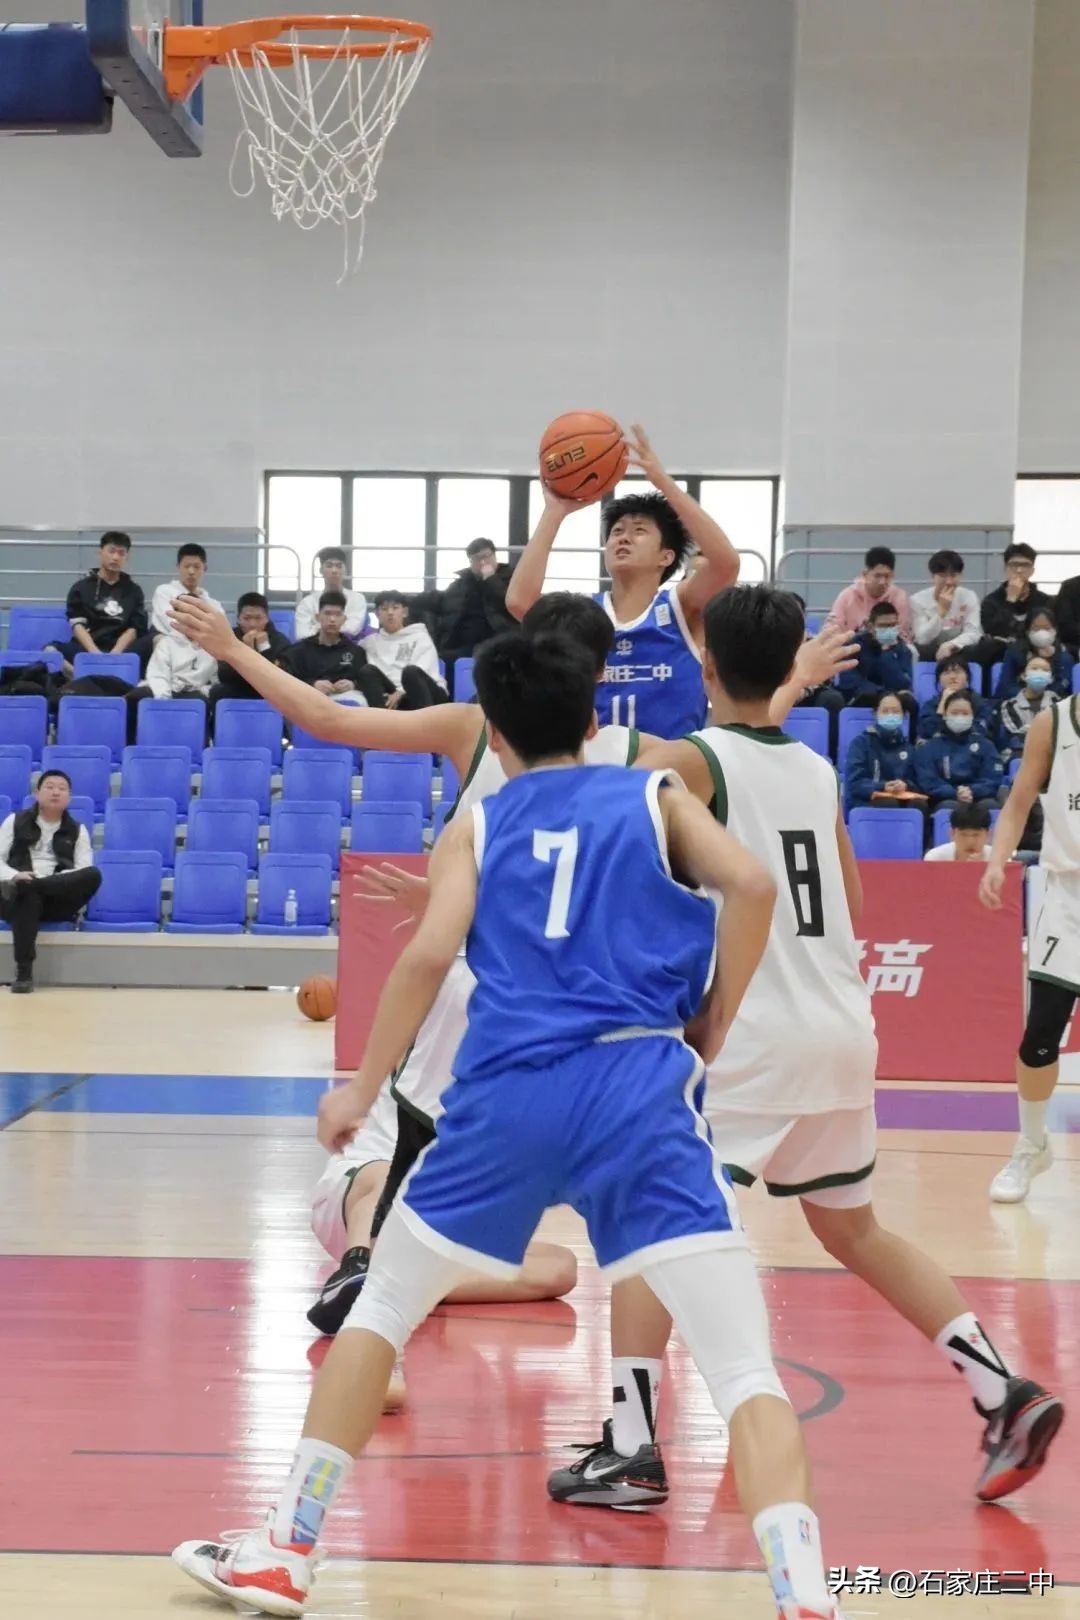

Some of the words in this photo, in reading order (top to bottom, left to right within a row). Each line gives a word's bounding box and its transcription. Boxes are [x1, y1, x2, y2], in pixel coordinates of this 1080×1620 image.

[612, 694, 636, 728] 11
[533, 826, 578, 938] 7
[778, 830, 824, 936] 8
[857, 939, 934, 998] 高
[1041, 935, 1059, 966] 7
